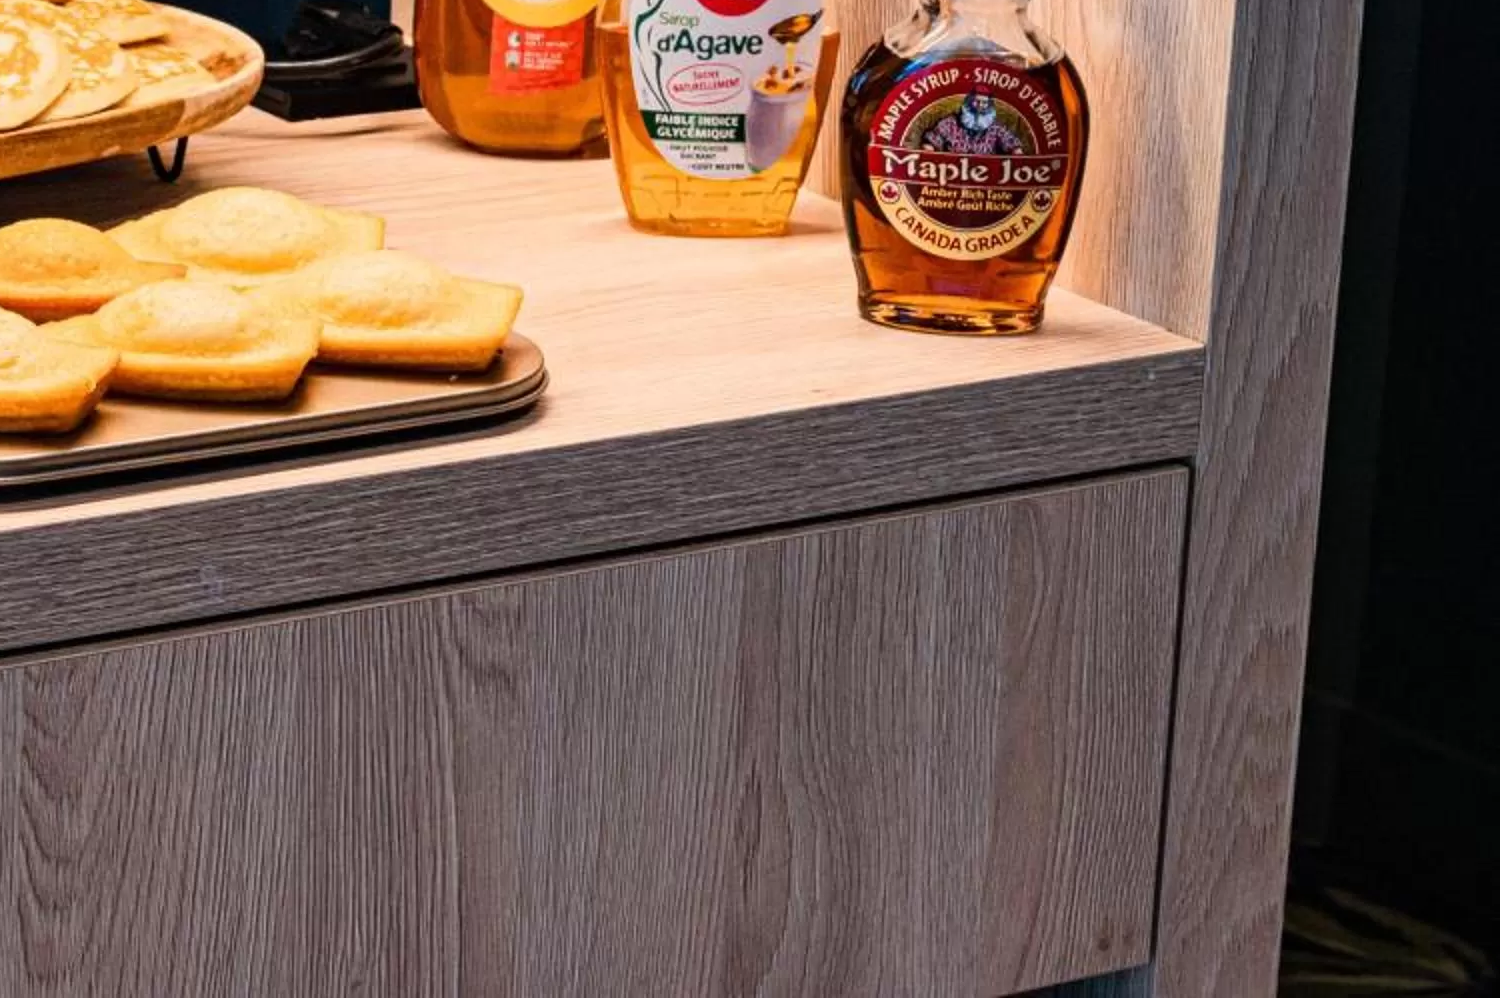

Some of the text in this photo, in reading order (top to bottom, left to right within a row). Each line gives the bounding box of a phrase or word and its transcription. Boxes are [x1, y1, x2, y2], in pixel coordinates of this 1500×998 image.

[659, 11, 699, 29] Sirop
[657, 28, 763, 60] d'Agave
[655, 114, 739, 127] FAIBLE INDICE
[876, 67, 1062, 149] MAPLE SYRUP SIROP D'ÉRABLE
[881, 149, 1051, 186] Maple Joe
[917, 196, 955, 210] Ambré
[985, 199, 1015, 212] Riche
[921, 185, 1013, 201] Amber Rich Taste
[895, 206, 1035, 252] CANADA GRADE A
